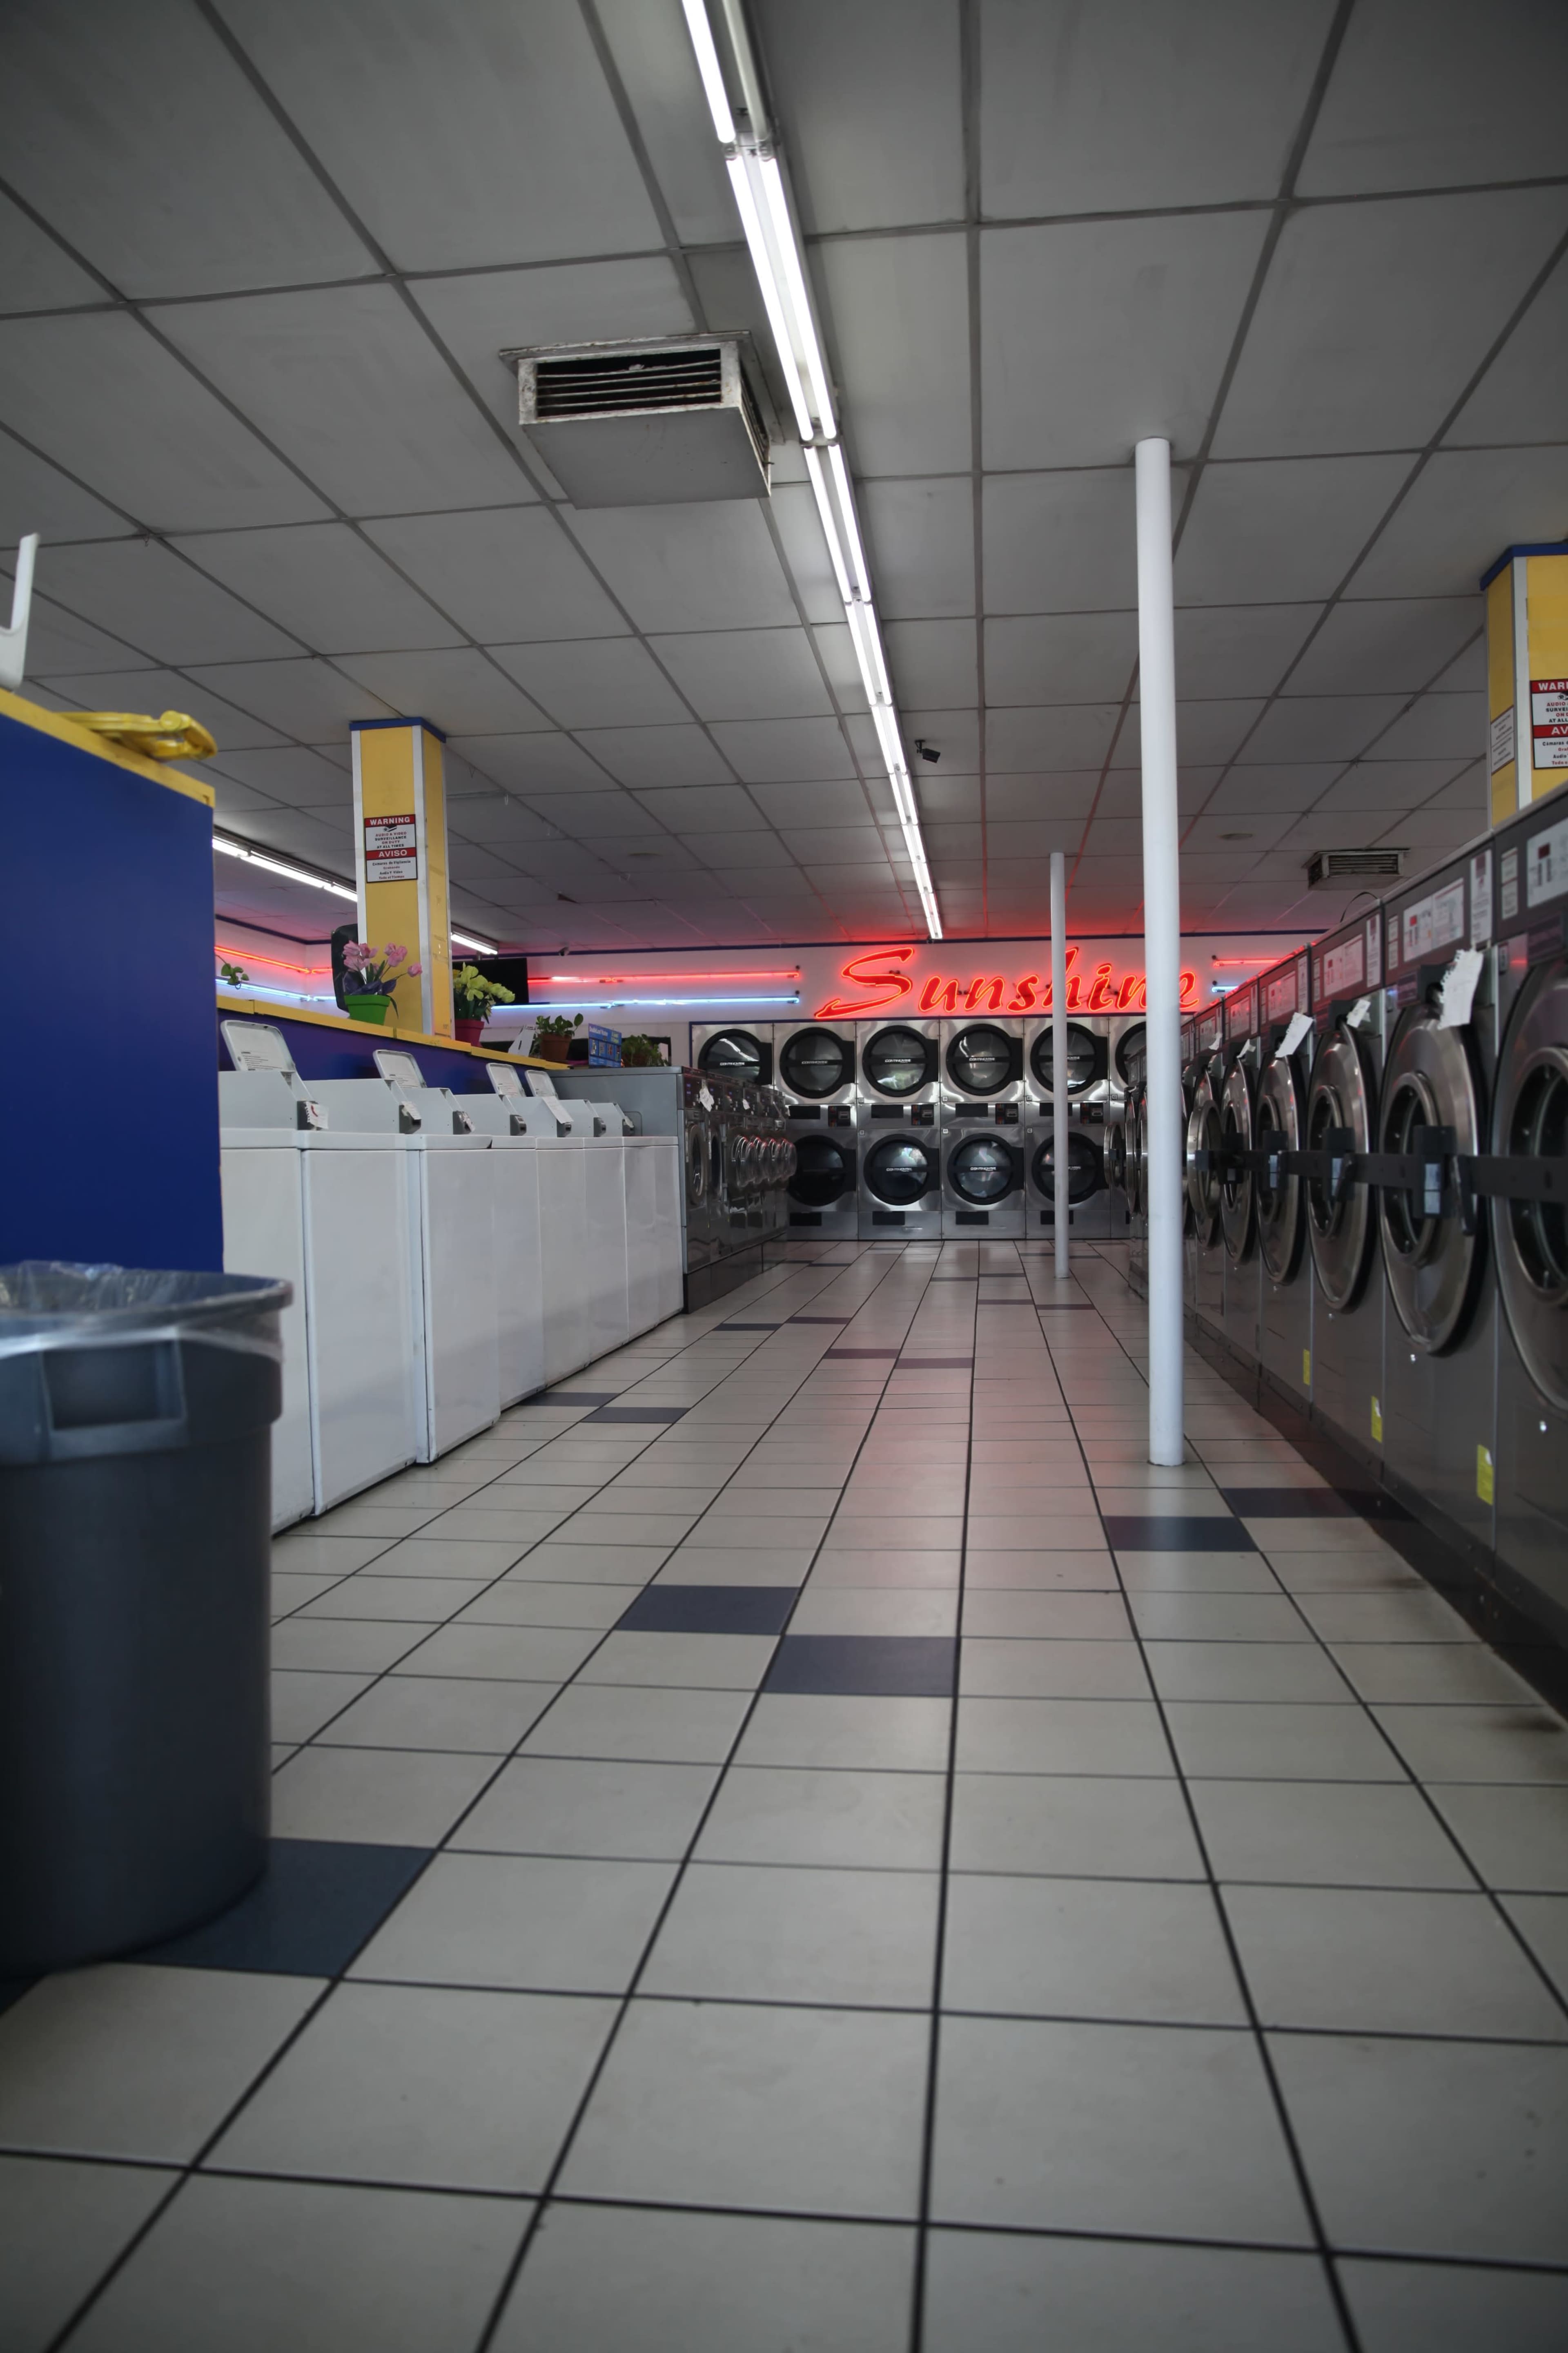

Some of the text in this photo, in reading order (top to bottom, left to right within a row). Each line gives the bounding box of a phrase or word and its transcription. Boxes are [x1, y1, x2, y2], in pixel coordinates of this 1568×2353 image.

[1538, 682, 1568, 691] WAR
[370, 817, 410, 825] WARNING
[814, 946, 1200, 1020] Sunshine
